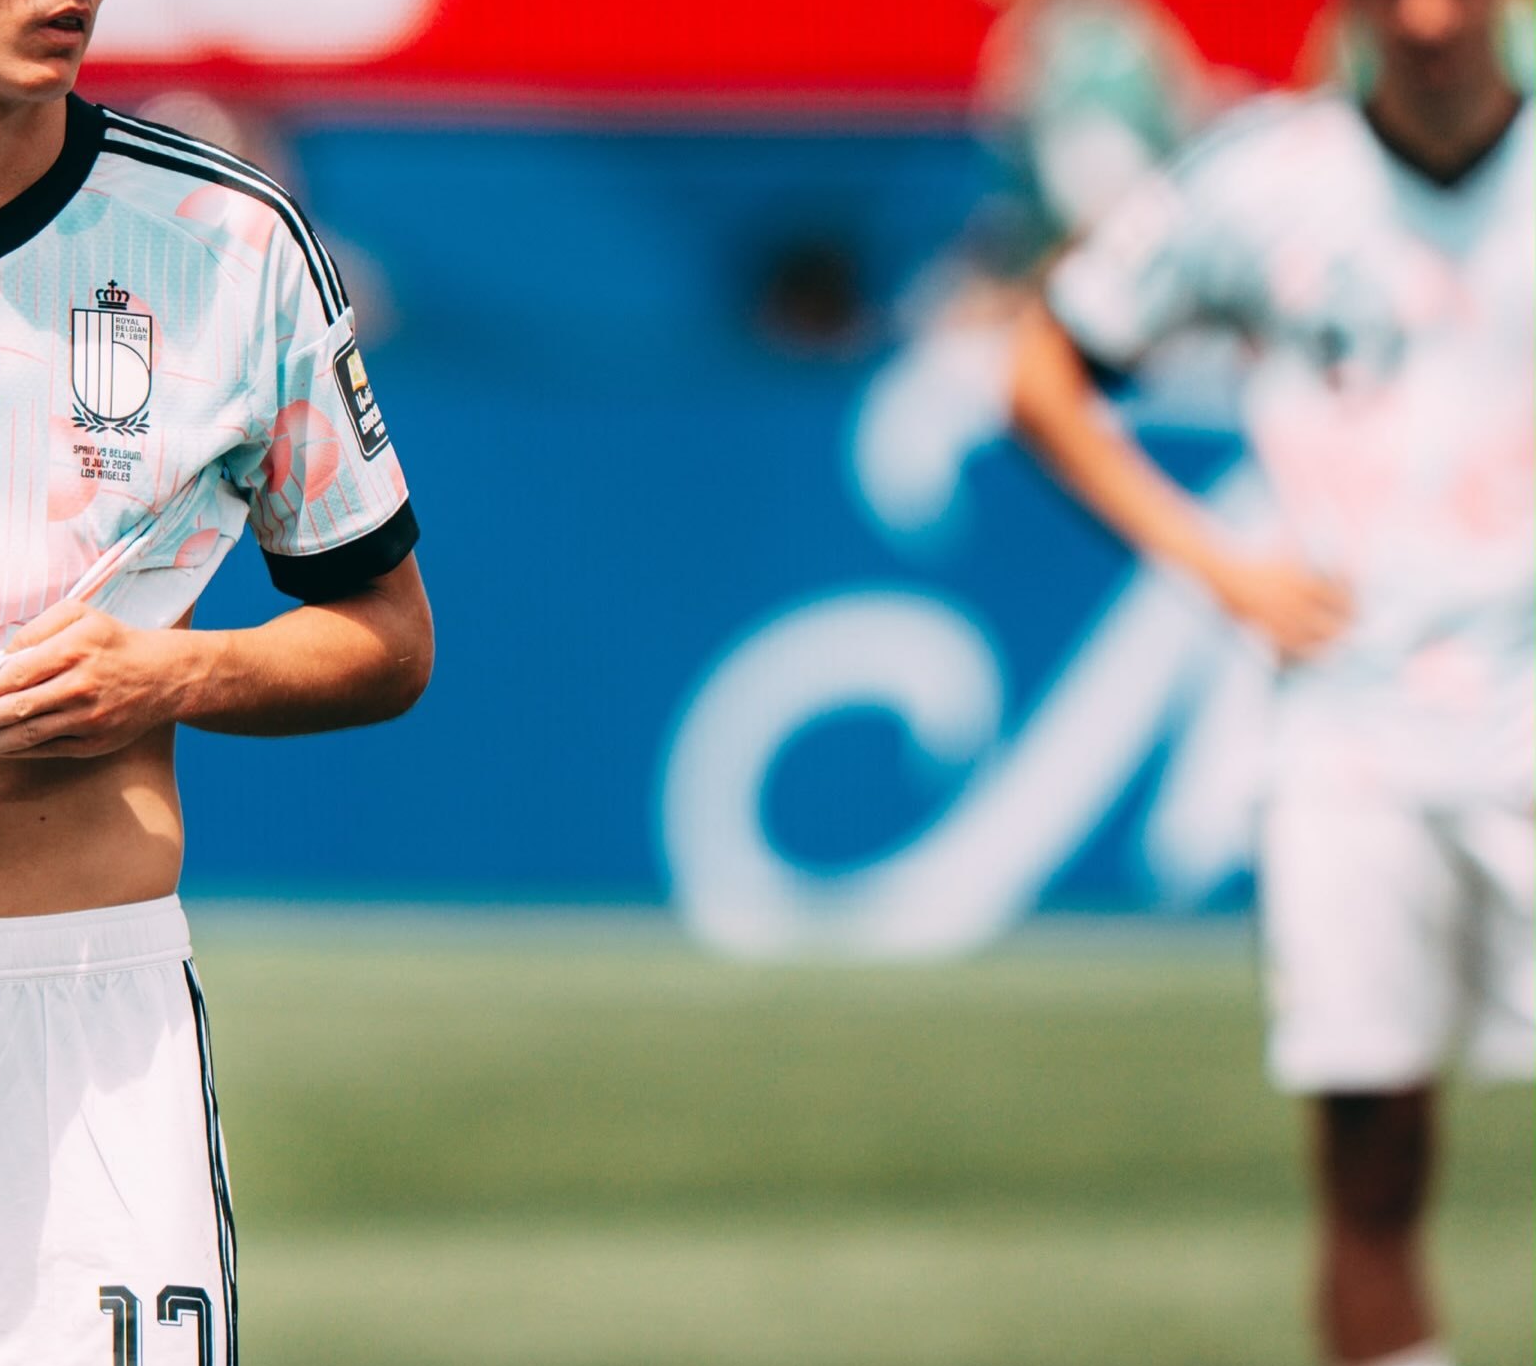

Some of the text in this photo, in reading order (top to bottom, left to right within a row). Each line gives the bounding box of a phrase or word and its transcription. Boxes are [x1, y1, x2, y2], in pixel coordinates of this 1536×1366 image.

[115, 316, 139, 326] ROYAL
[115, 325, 148, 333] BELGIAN
[129, 333, 148, 341] 1895
[73, 444, 142, 461] SPAIN VS BELGIUM
[81, 457, 132, 471] 10 JULY 2026
[80, 468, 131, 482] LOS ANGELES
